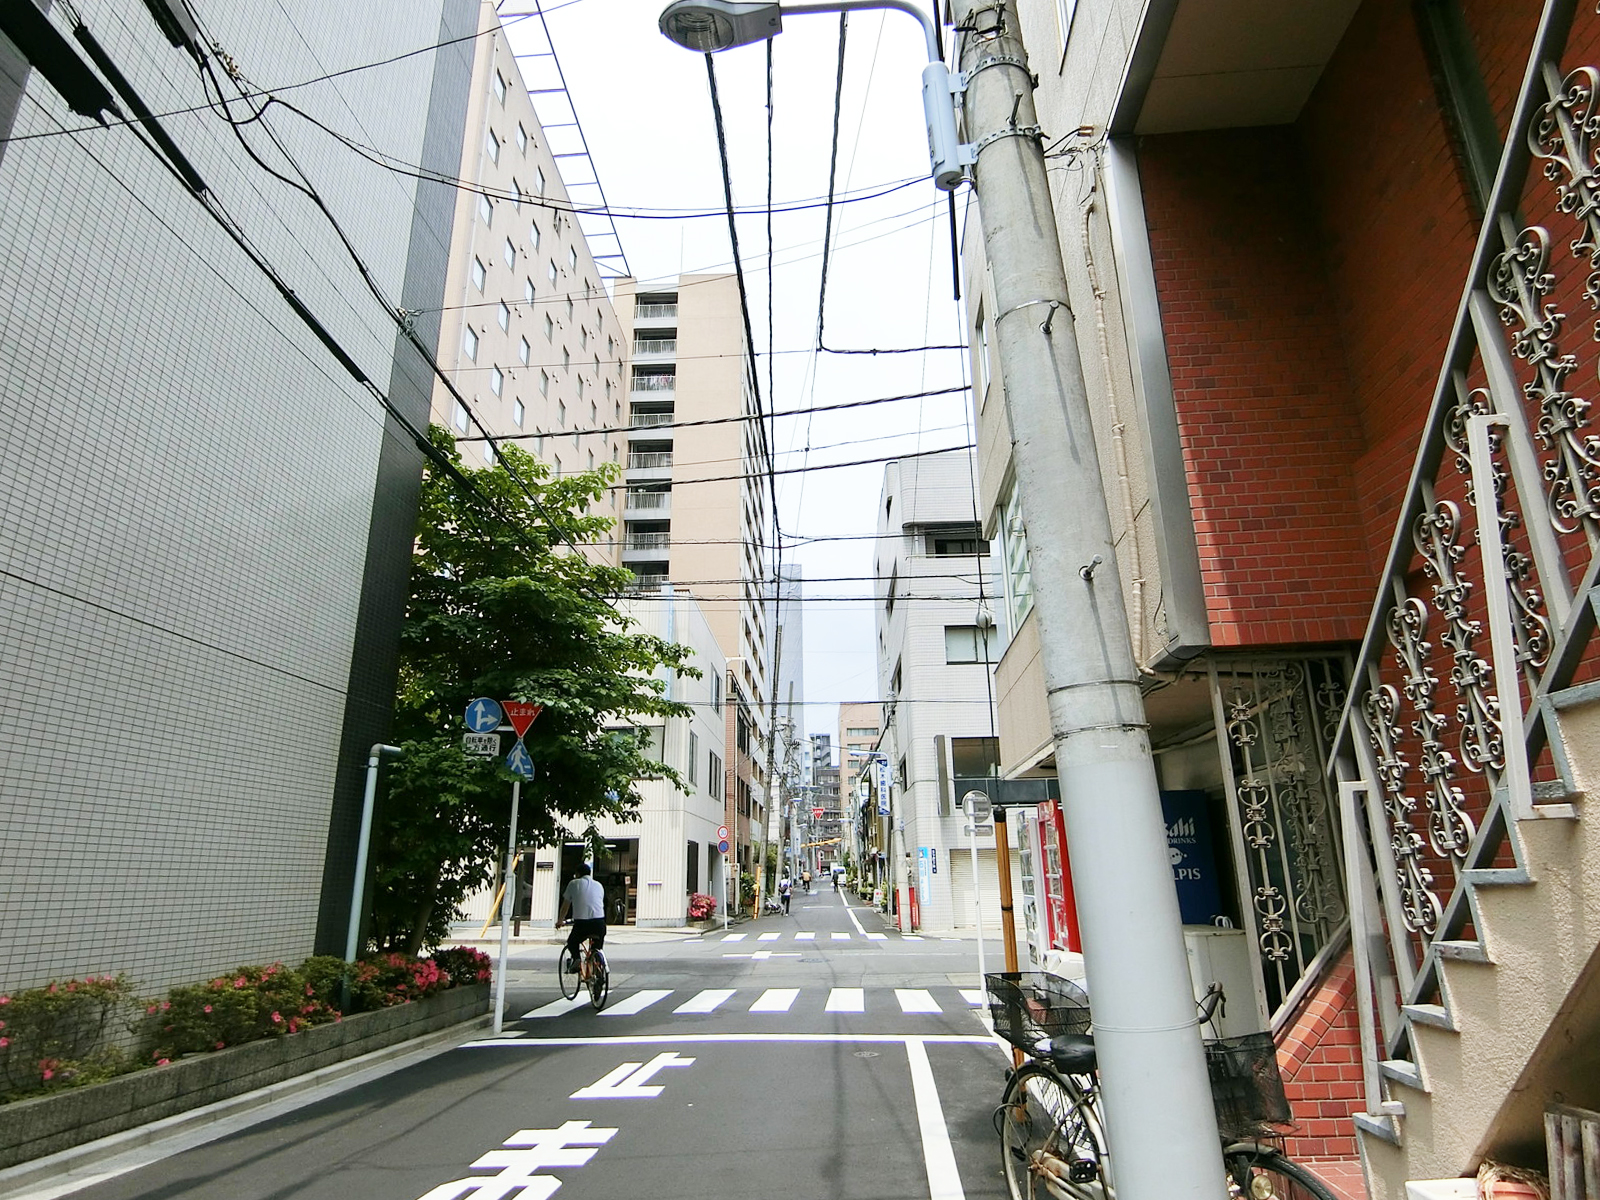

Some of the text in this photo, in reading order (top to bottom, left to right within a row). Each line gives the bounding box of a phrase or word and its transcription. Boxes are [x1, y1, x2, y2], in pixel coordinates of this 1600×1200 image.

[510, 708, 535, 717] 止まれ
[465, 736, 497, 745] 自転車を除く
[465, 744, 497, 752] 一方通行
